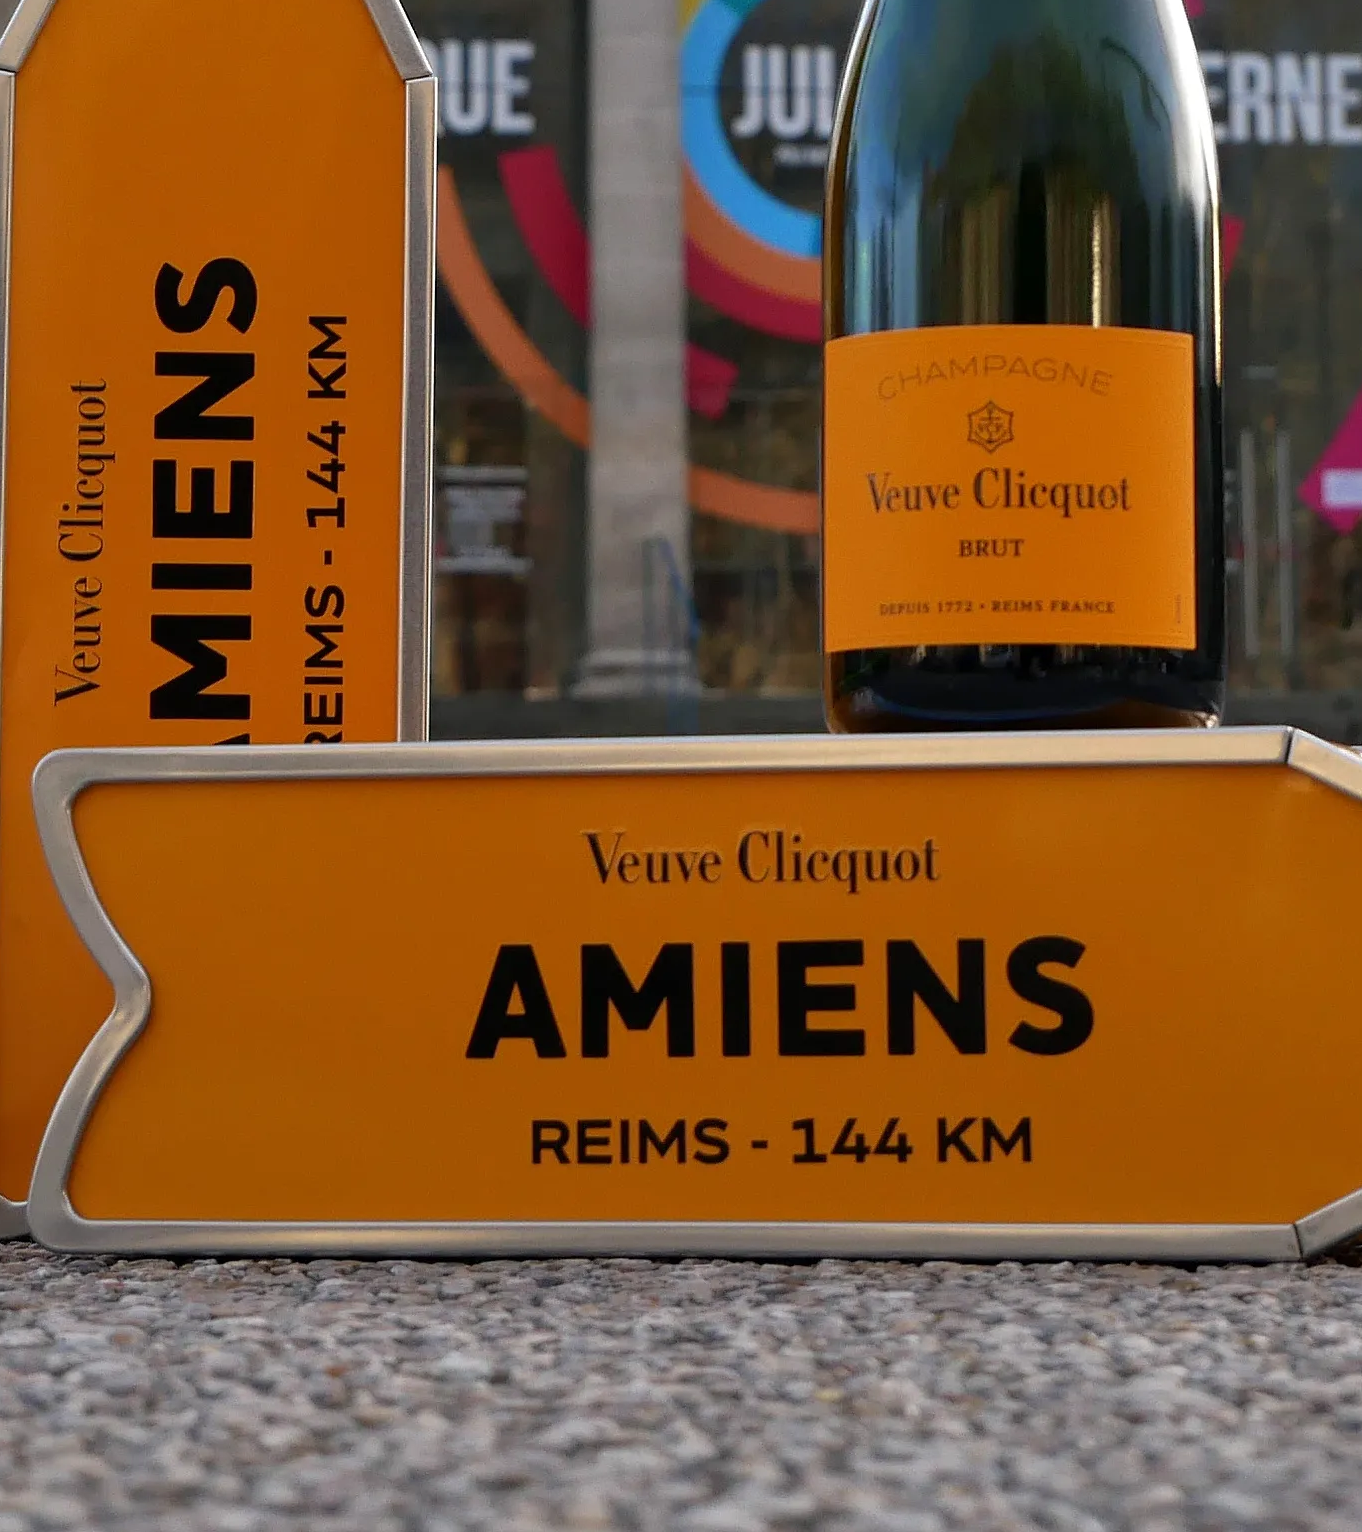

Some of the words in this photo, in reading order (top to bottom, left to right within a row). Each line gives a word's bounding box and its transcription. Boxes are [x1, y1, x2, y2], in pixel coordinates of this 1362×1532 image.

[422, 37, 537, 137] UE
[731, 43, 837, 139] JUL
[308, 315, 348, 399] KM
[877, 354, 1114, 400] CHAMPAGNE
[57, 377, 116, 562] Clicquot
[149, 257, 258, 745] MIENS
[306, 420, 346, 529] 144
[867, 471, 960, 514] Veuve
[973, 467, 1131, 518] Clicquot
[958, 538, 1025, 558] BRUT
[54, 576, 103, 707] Veuve
[880, 601, 930, 617] DEPUIS
[937, 600, 973, 614] 1772
[991, 599, 1043, 614] REIMS
[1050, 599, 1115, 614] FRANCE
[586, 831, 722, 884] Veuve
[737, 830, 941, 894] Clicquot
[465, 934, 1095, 1059] AMIENS
[531, 1118, 730, 1165] REIMS
[792, 1117, 913, 1164] 144
[937, 1117, 1033, 1164] KM
